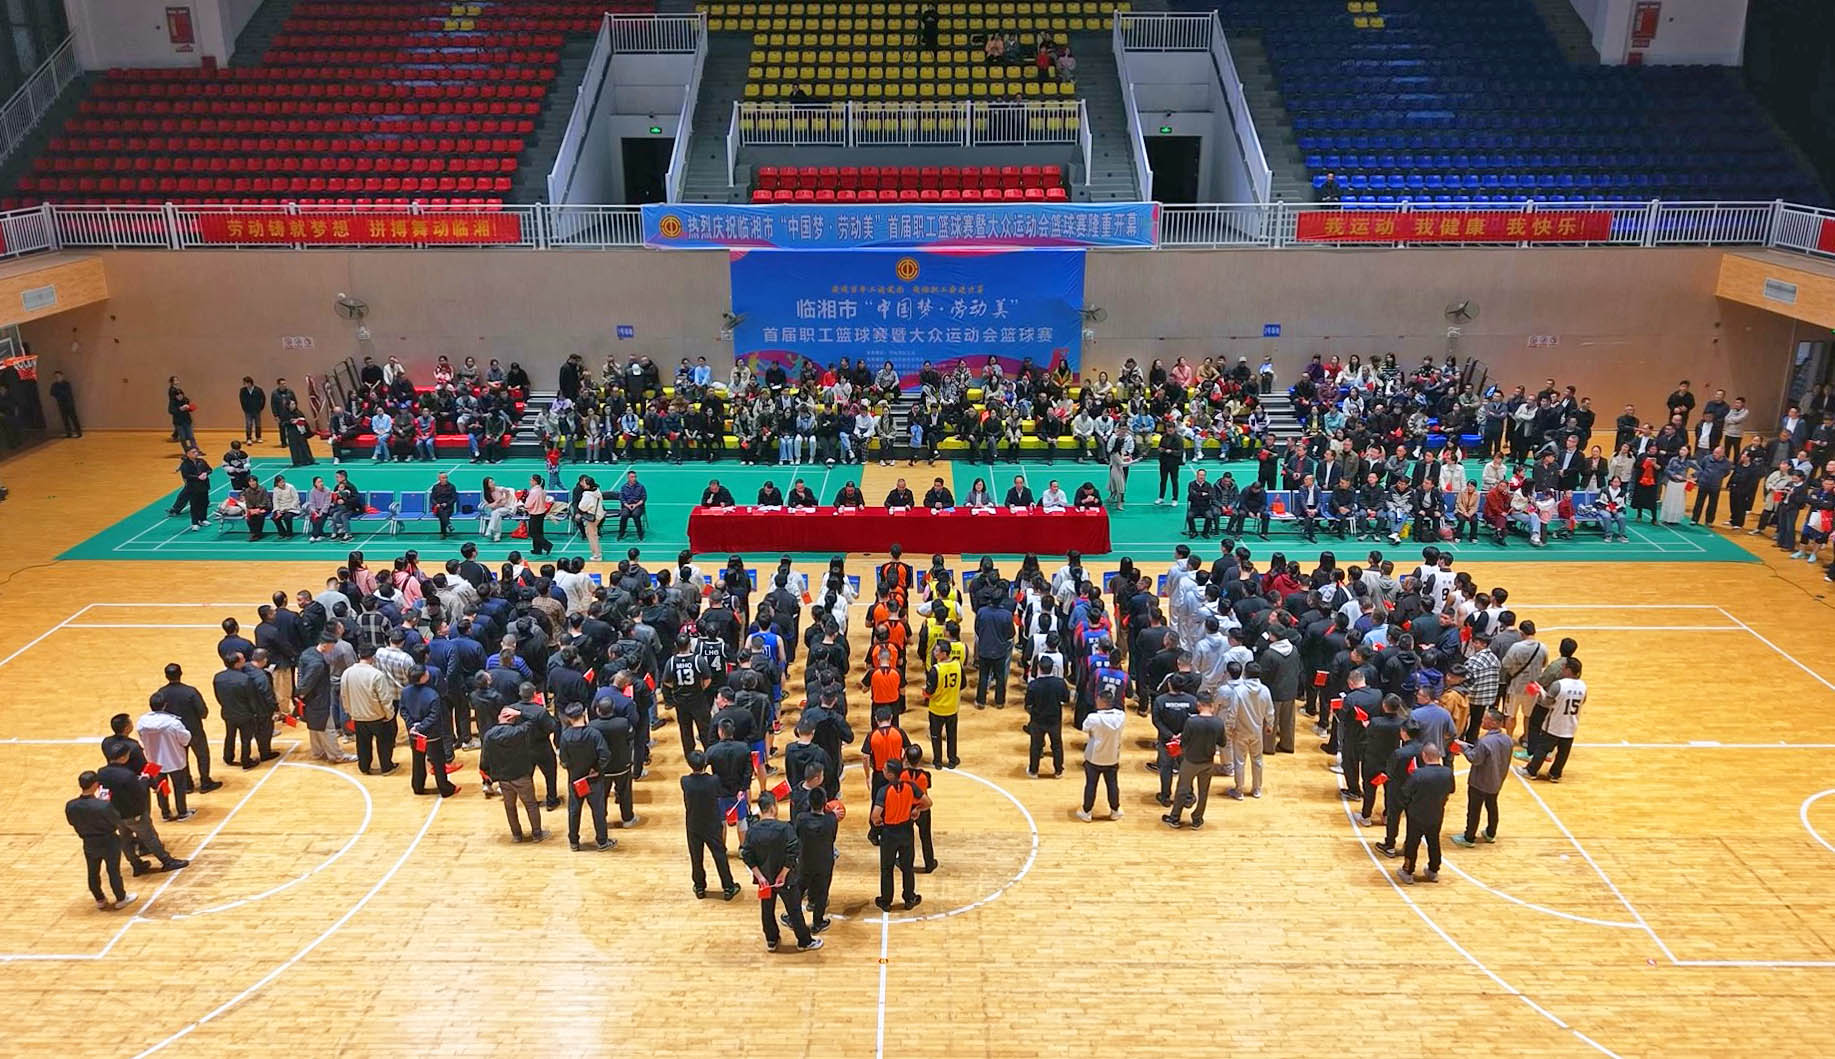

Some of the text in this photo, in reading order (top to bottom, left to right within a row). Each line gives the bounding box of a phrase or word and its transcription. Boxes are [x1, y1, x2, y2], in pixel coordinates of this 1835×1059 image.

[226, 219, 350, 238] 劳动铸就梦想
[1324, 217, 1395, 236] 我运动
[1415, 217, 1486, 236] 我健康
[763, 326, 1053, 344] 首届职工篮球赛暨大众运动会篮球赛
[676, 669, 695, 686] 13
[944, 673, 957, 688] 13
[1563, 699, 1581, 715] 15
